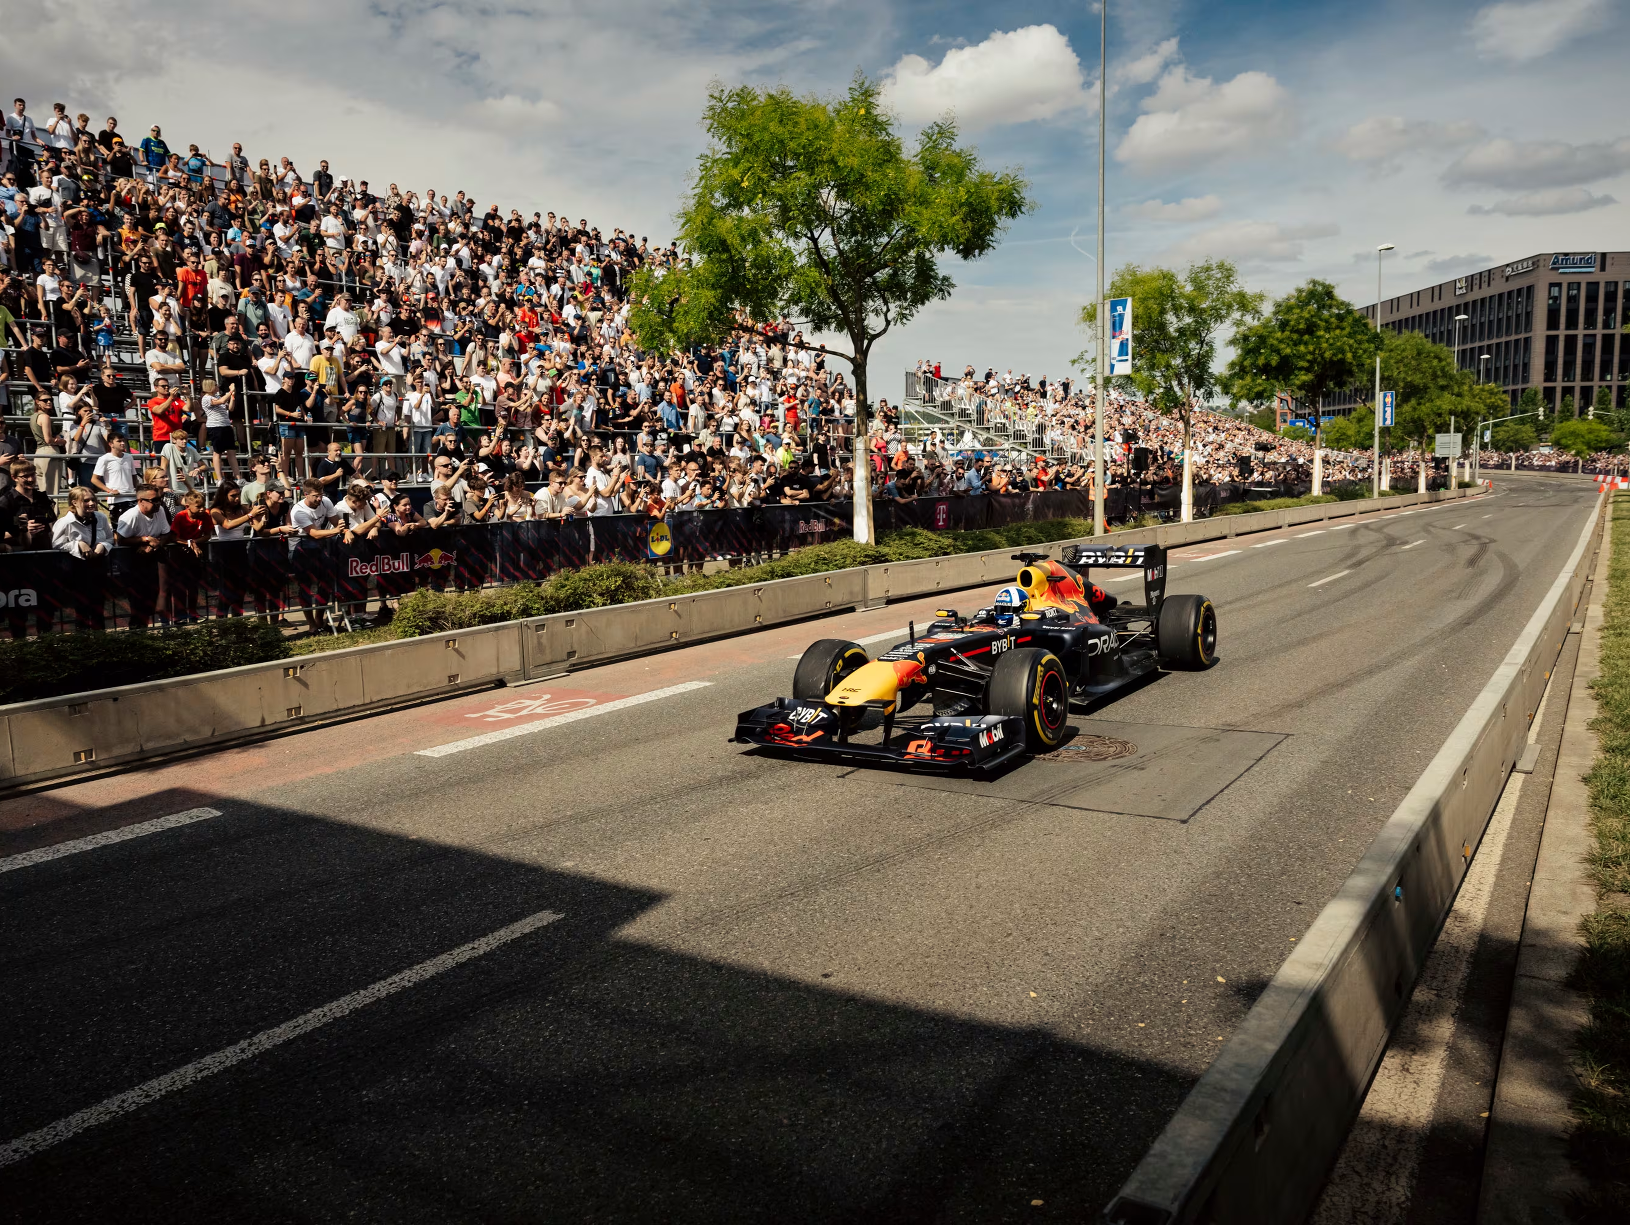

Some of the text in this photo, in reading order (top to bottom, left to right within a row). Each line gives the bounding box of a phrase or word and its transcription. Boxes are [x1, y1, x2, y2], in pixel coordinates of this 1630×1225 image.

[1551, 254, 1596, 266] Amundi
[348, 553, 410, 577] Red Bull
[992, 635, 1015, 655] BYBIT
[979, 723, 1005, 749] Mobil
